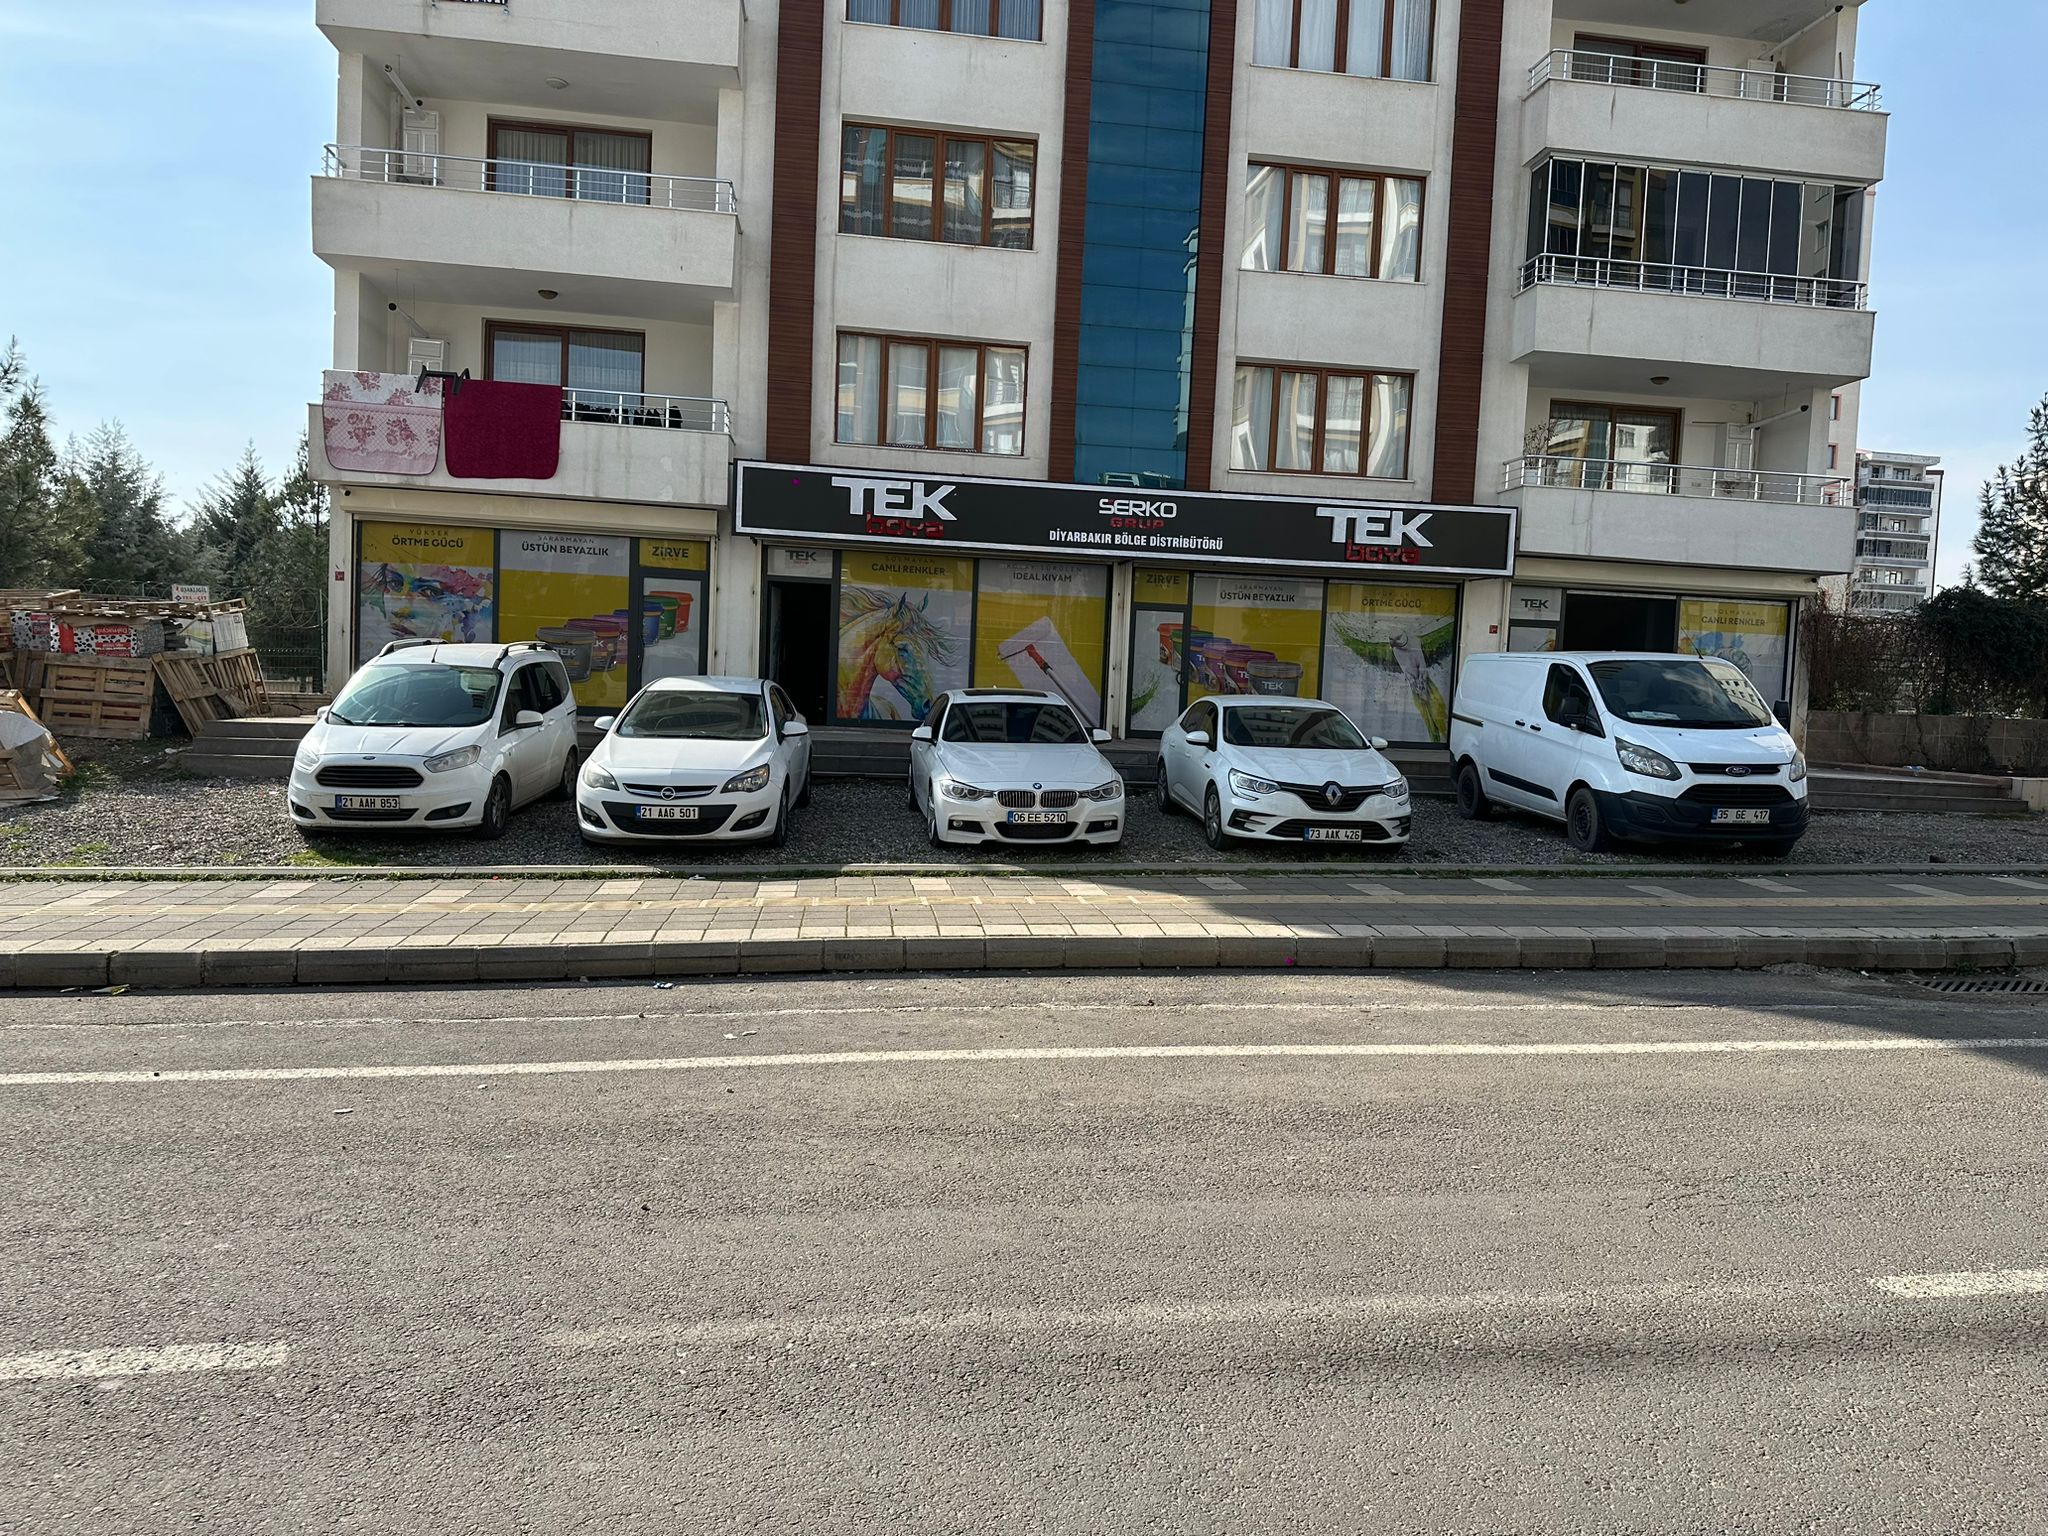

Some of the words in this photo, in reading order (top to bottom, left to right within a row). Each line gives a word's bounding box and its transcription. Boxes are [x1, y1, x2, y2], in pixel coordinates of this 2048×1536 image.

[832, 476, 957, 520] TEK
[1099, 498, 1178, 518] SERKO
[866, 512, 944, 538] boya
[1110, 517, 1165, 529] GRUP
[1316, 507, 1434, 547] TEK
[391, 534, 430, 546] ÖRTME
[431, 537, 464, 548] GÜCÜ
[1049, 528, 1112, 544] DİYARBAKIR
[1114, 531, 1147, 546] BÖLGE
[1149, 533, 1224, 550] DİSTRİBÜTÖRÜ
[521, 541, 557, 553] ÜSTÜN
[559, 545, 609, 556] BEYAZLIK
[1346, 539, 1420, 563] boya
[785, 550, 817, 561] TEK
[871, 563, 901, 573] CANLI
[902, 565, 946, 576] RENKLER
[1041, 573, 1072, 583] KIVAM
[1220, 590, 1251, 601] ÜSTÜN
[1252, 593, 1296, 603] BEYAZLIK
[1520, 598, 1549, 609] TEK
[1701, 616, 1727, 625] CANLI
[1728, 618, 1766, 627] RENKLER
[1261, 681, 1284, 690] TEK
[342, 797, 353, 808] 21
[359, 797, 376, 808] AAH
[380, 798, 398, 809] 853
[641, 807, 653, 818] 21
[657, 807, 675, 818] AAG
[679, 808, 697, 819] 501
[1013, 812, 1026, 823] 06
[1027, 812, 1042, 823] EE
[1043, 813, 1067, 824] 5210
[1717, 809, 1729, 820] 35
[1735, 809, 1747, 820] GE
[1753, 810, 1769, 820] 417
[1309, 829, 1321, 839] 73
[1325, 829, 1341, 840] AAK
[1344, 830, 1360, 840] 426
